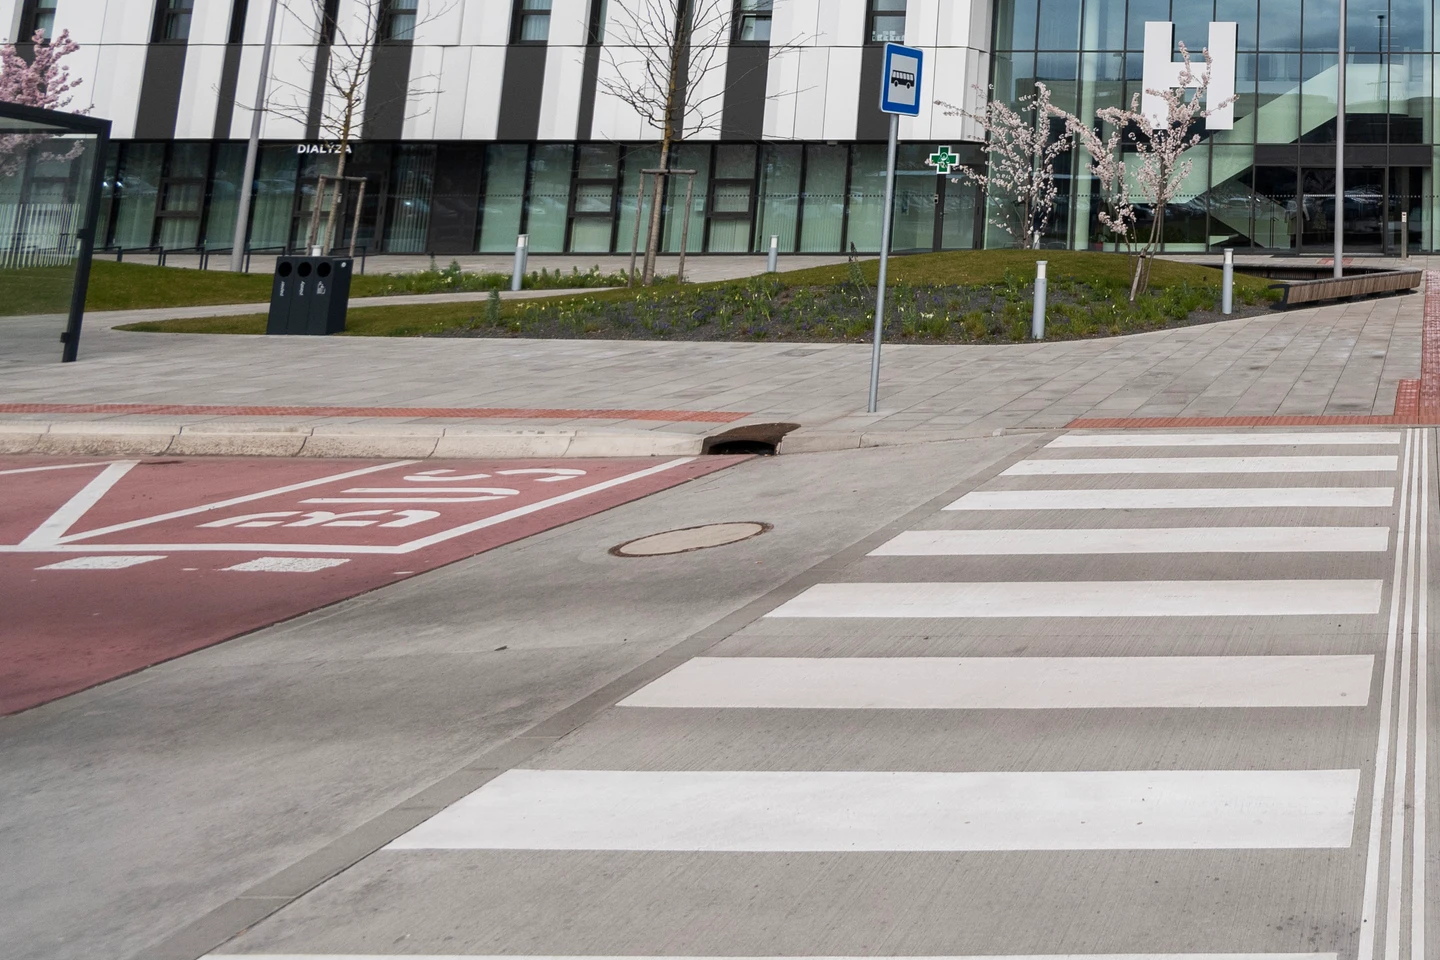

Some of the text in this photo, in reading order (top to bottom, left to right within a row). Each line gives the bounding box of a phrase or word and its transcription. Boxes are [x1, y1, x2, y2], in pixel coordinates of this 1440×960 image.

[1141, 21, 1237, 130] H
[297, 142, 352, 154] DIALÝZA
[195, 468, 588, 528] BUS
